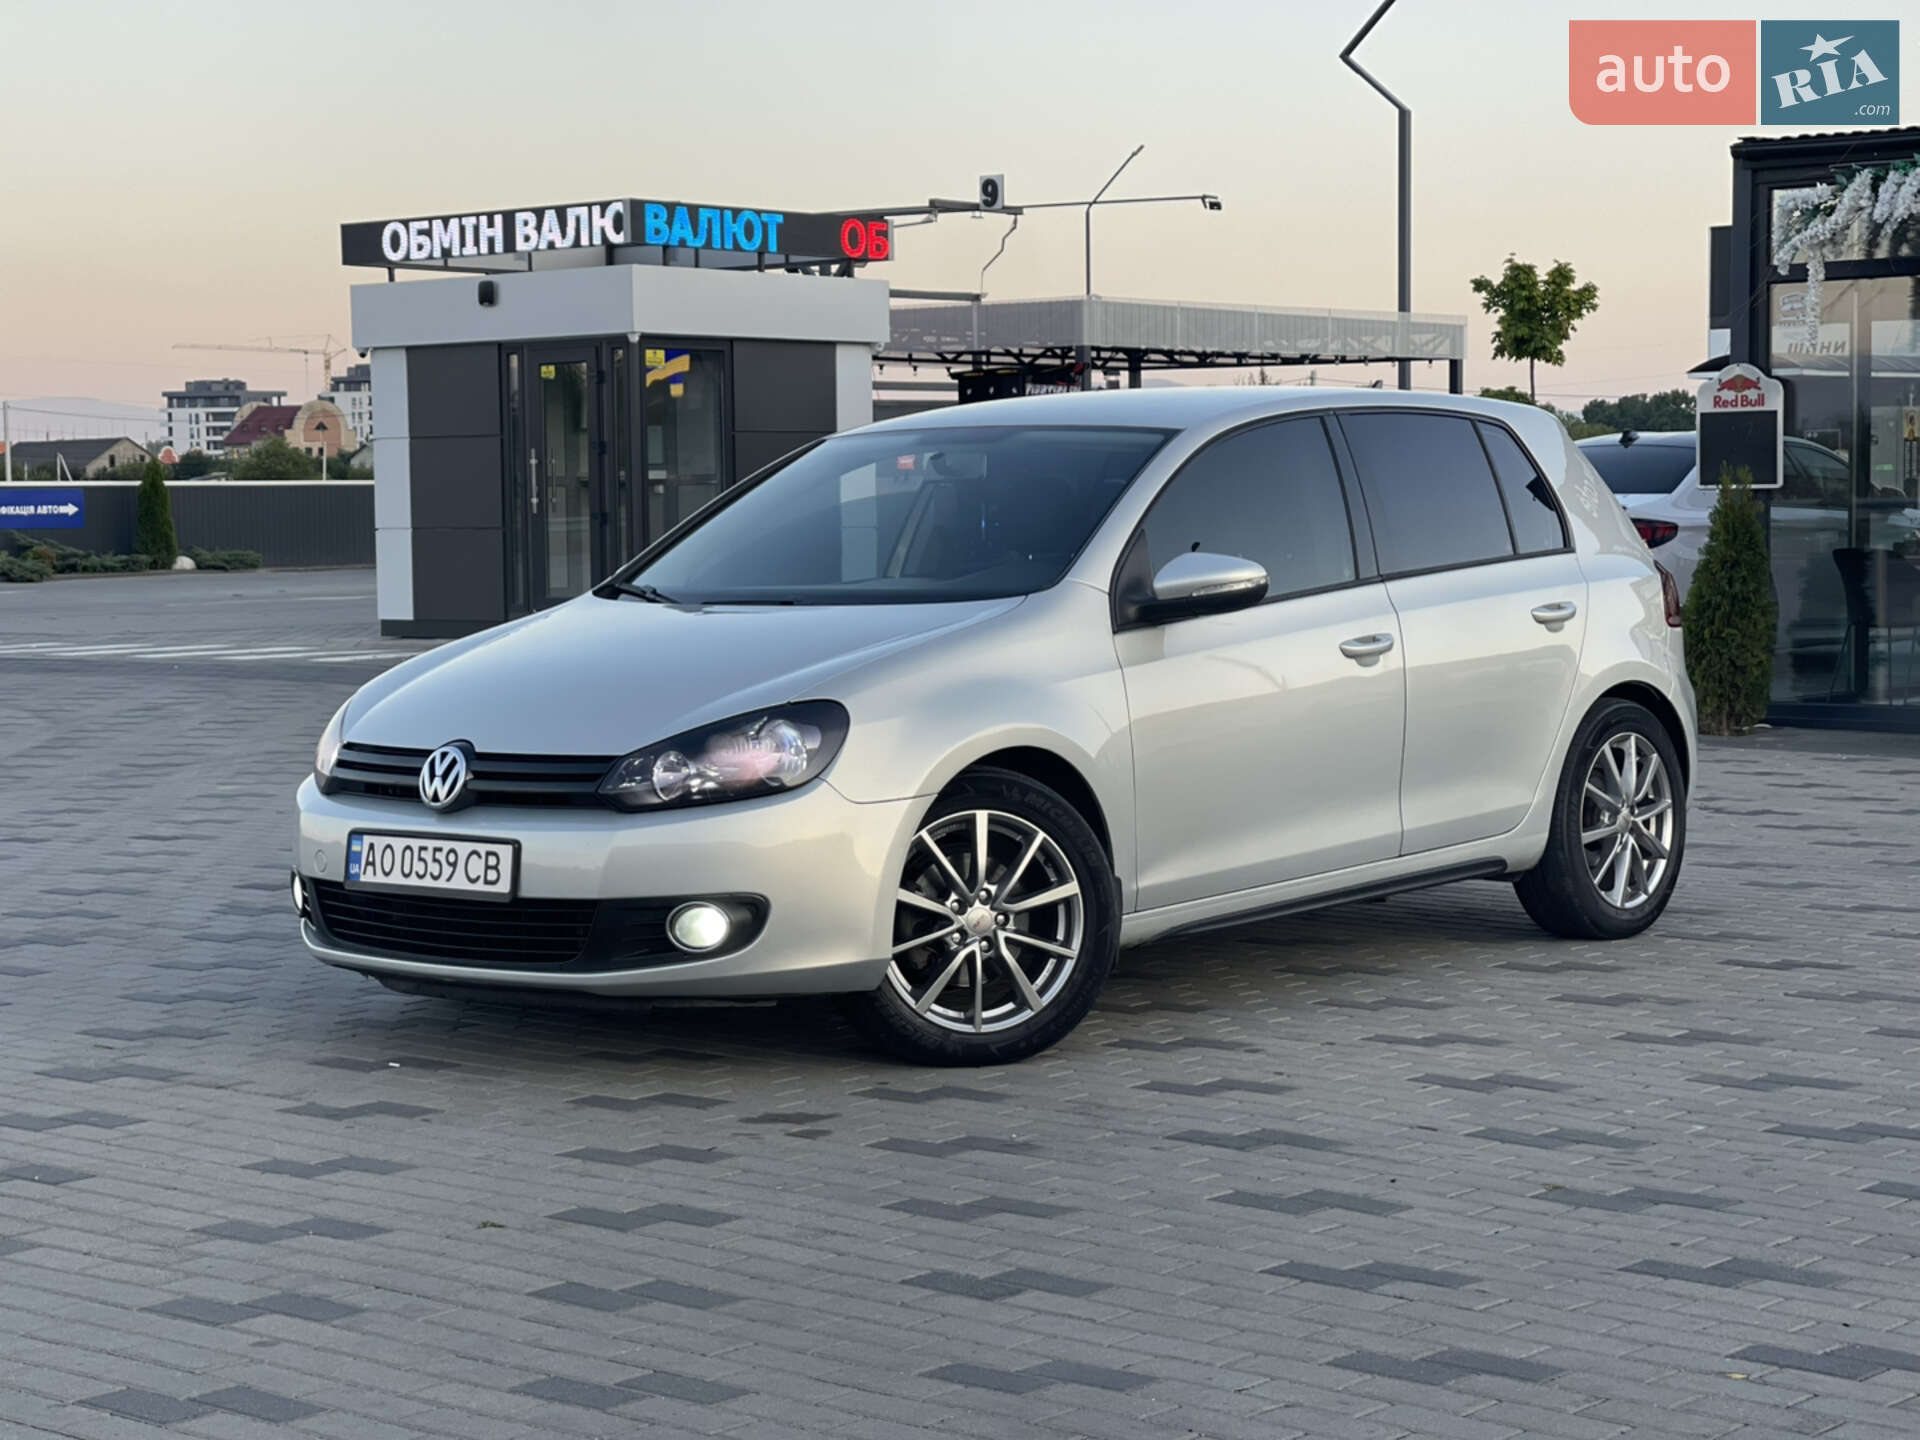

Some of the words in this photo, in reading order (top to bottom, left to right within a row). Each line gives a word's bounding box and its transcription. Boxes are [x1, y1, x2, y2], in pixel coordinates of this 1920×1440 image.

[982, 178, 999, 208] 9
[382, 213, 504, 262] ОБМІН
[515, 201, 625, 252] ВАЛЮ
[644, 203, 784, 253] ВАЛЮТ
[840, 218, 890, 260] ОБ
[1713, 394, 1739, 409] Red
[1740, 392, 1766, 408] Bull
[363, 842, 396, 877] AO
[401, 844, 459, 882] 0559
[464, 849, 501, 886] CB
